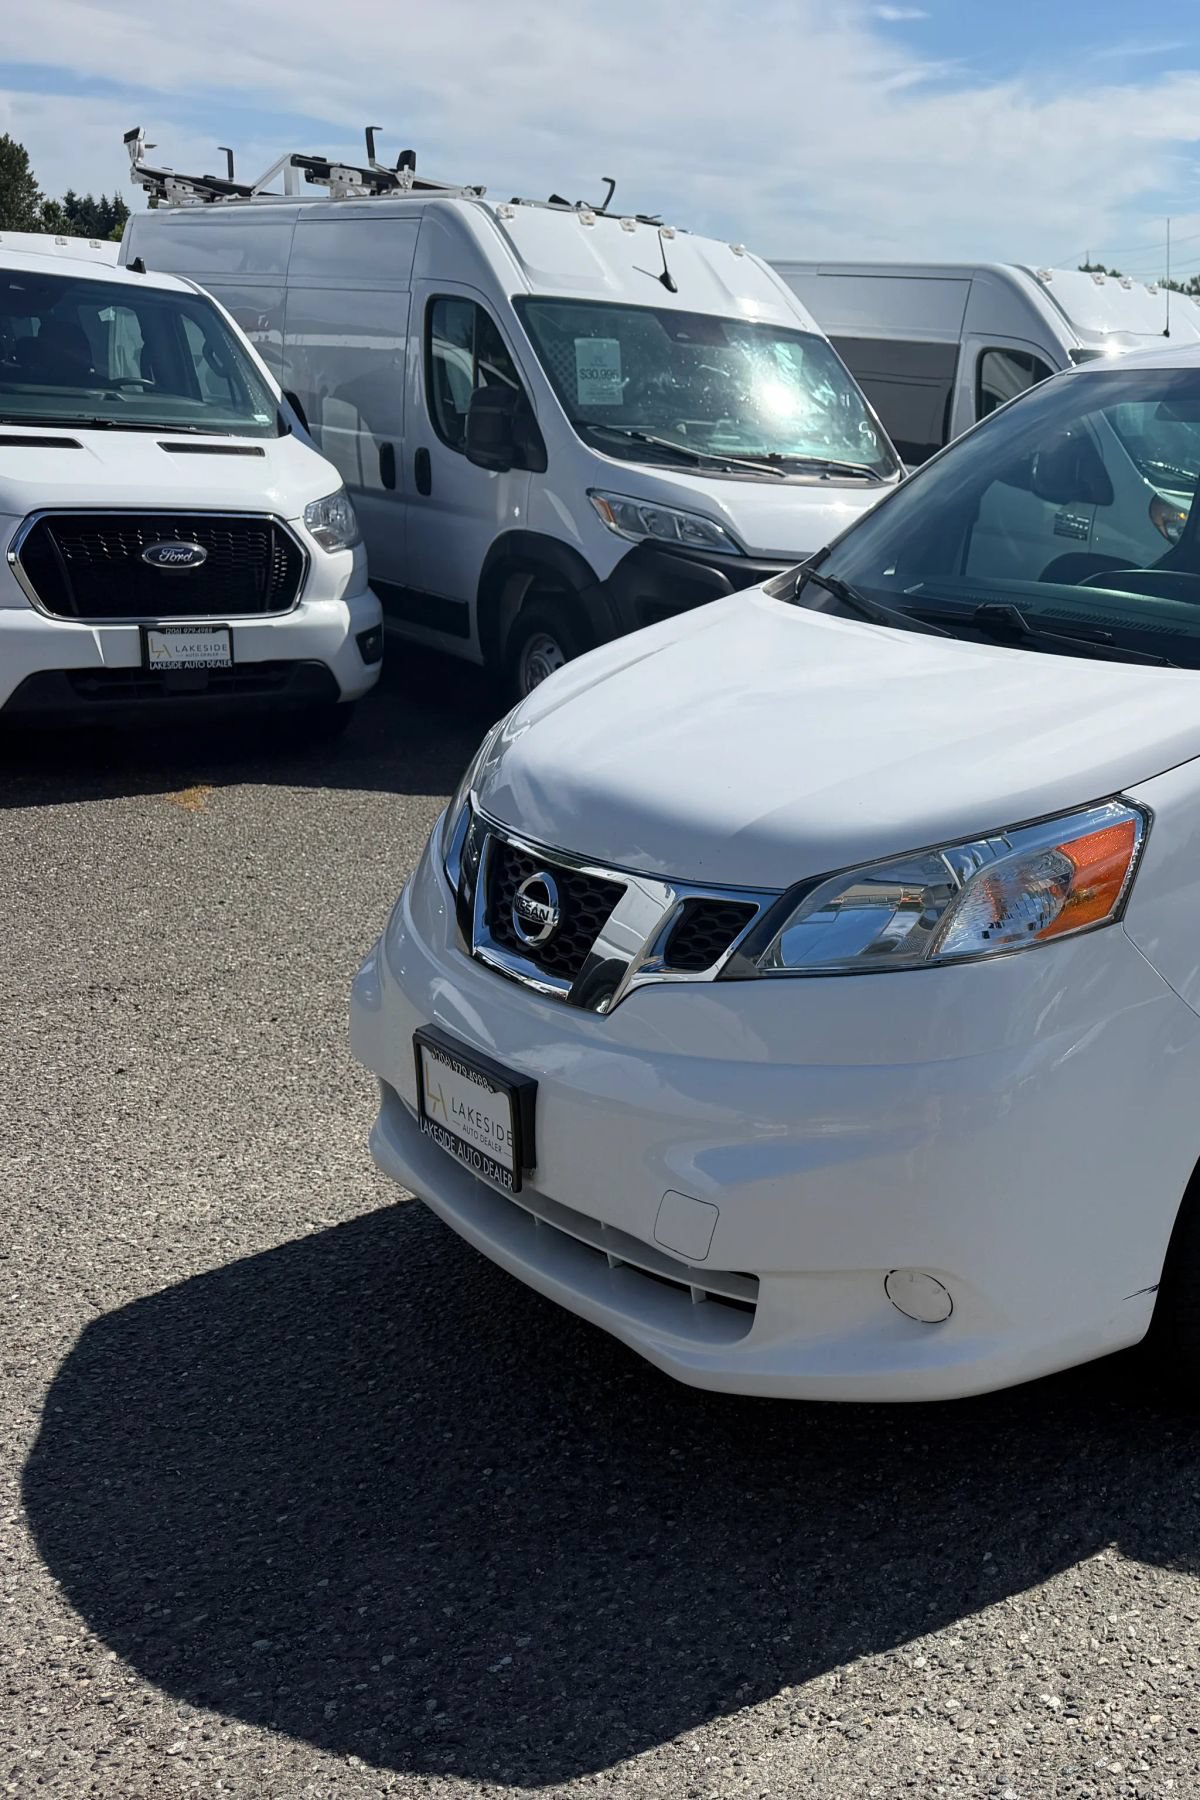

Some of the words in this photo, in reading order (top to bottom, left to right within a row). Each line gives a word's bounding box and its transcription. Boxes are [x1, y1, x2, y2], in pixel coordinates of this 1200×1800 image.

[158, 547, 194, 563] Ford
[175, 643, 228, 653] LAKESIDE
[149, 661, 183, 670] LAKESIDE
[185, 660, 205, 669] AUTO
[206, 659, 233, 668] DEALER
[451, 1097, 513, 1147] LAKESIDE
[462, 1123, 479, 1139] AUTO
[480, 1132, 502, 1153] DEALER
[420, 1118, 456, 1152] LAKESIDE
[457, 1143, 482, 1170] AUTO
[483, 1157, 513, 1191] DEALER
